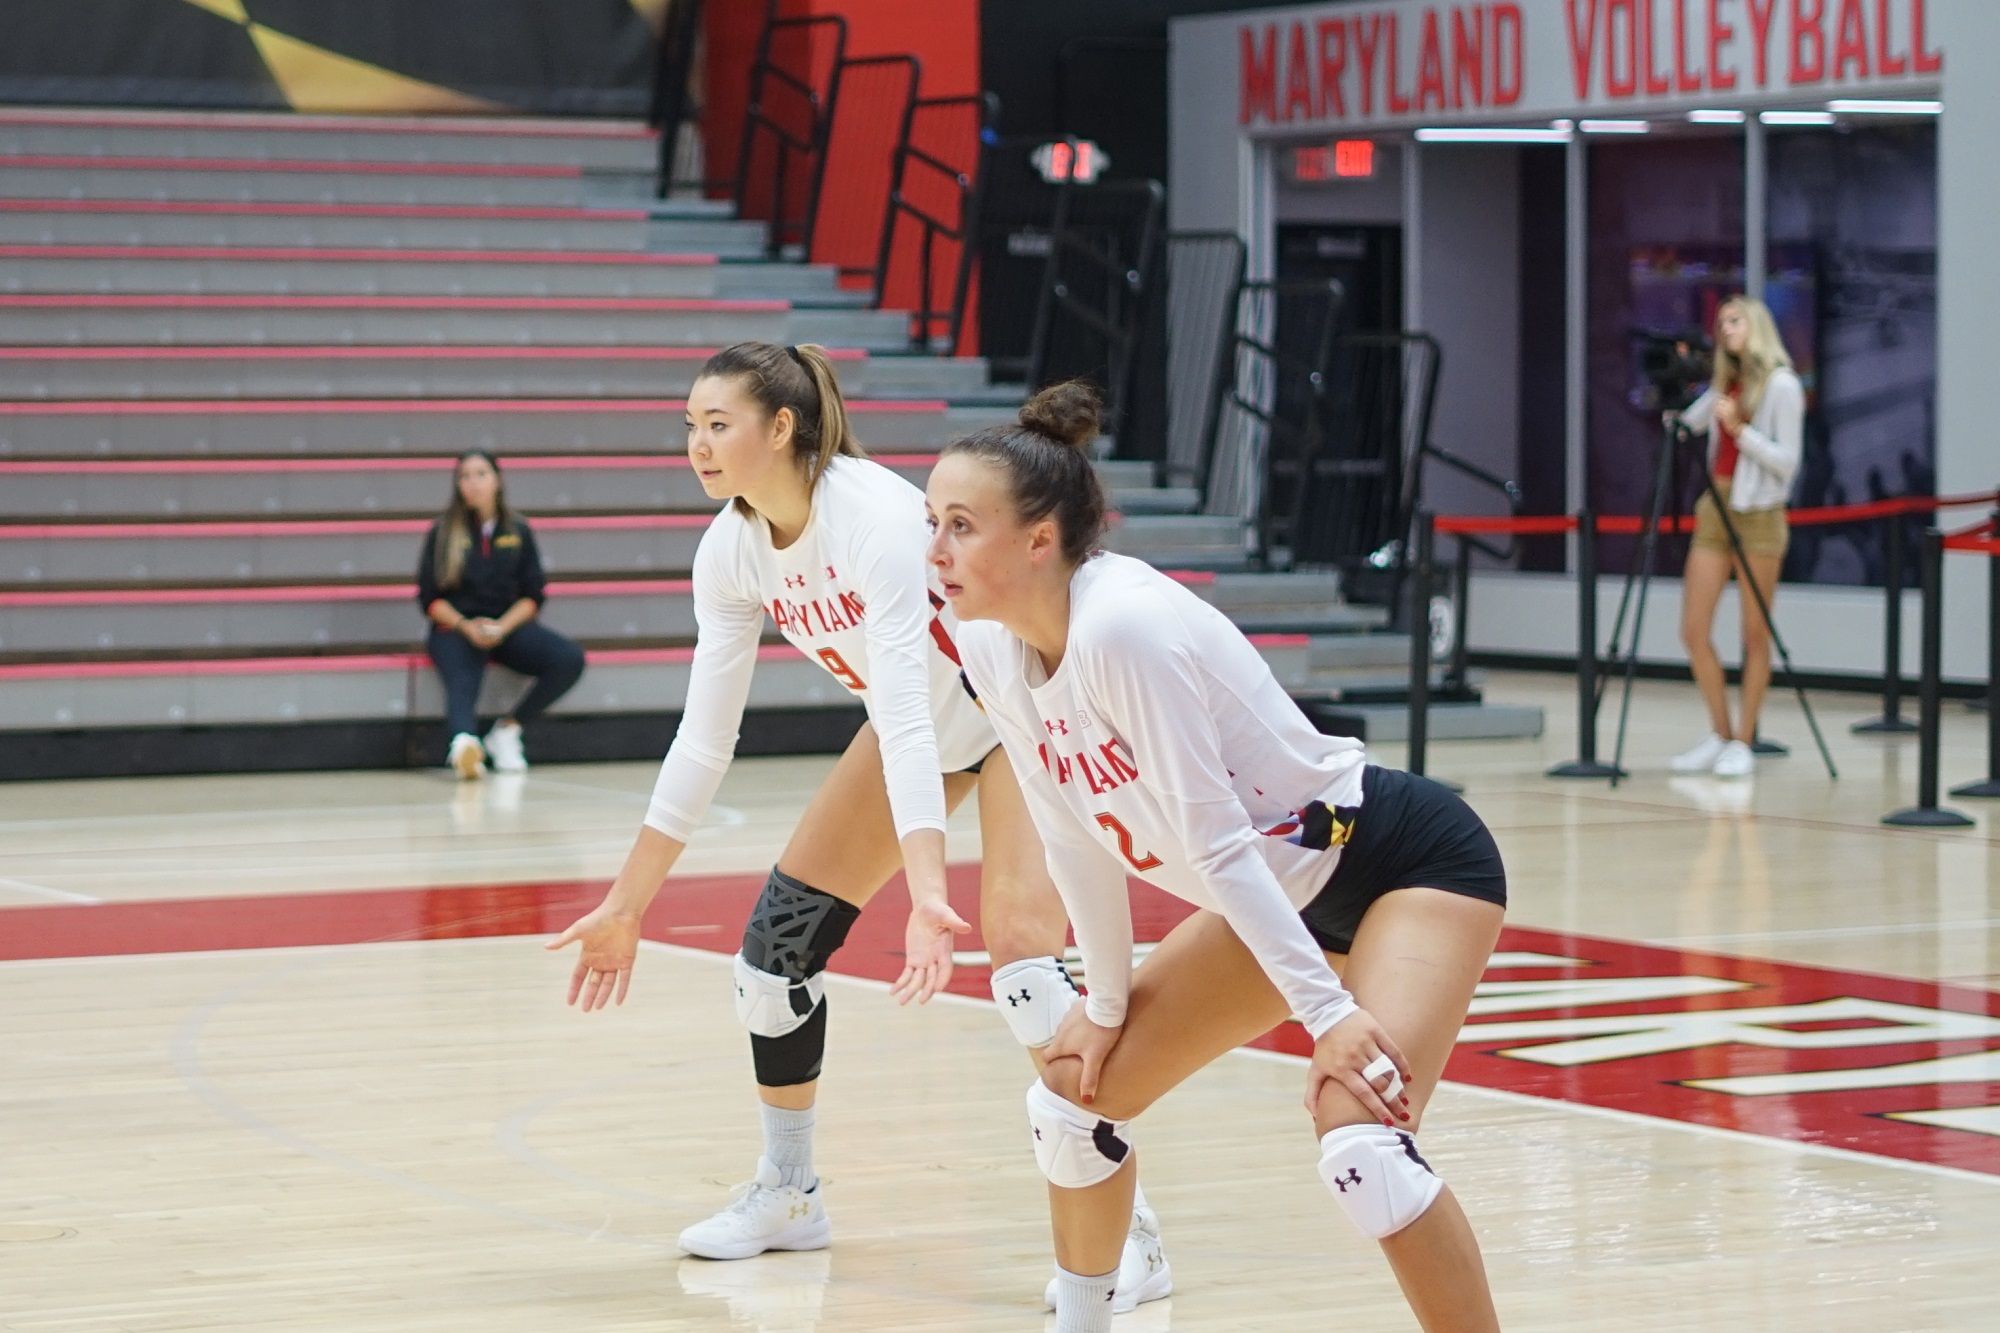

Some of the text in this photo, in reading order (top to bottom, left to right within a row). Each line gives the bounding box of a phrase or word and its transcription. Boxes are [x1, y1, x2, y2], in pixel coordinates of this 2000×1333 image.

[1239, 0, 1943, 124] MARYLAND VOLLEYBALL
[816, 646, 867, 690] 9
[1093, 811, 1164, 872] 2
